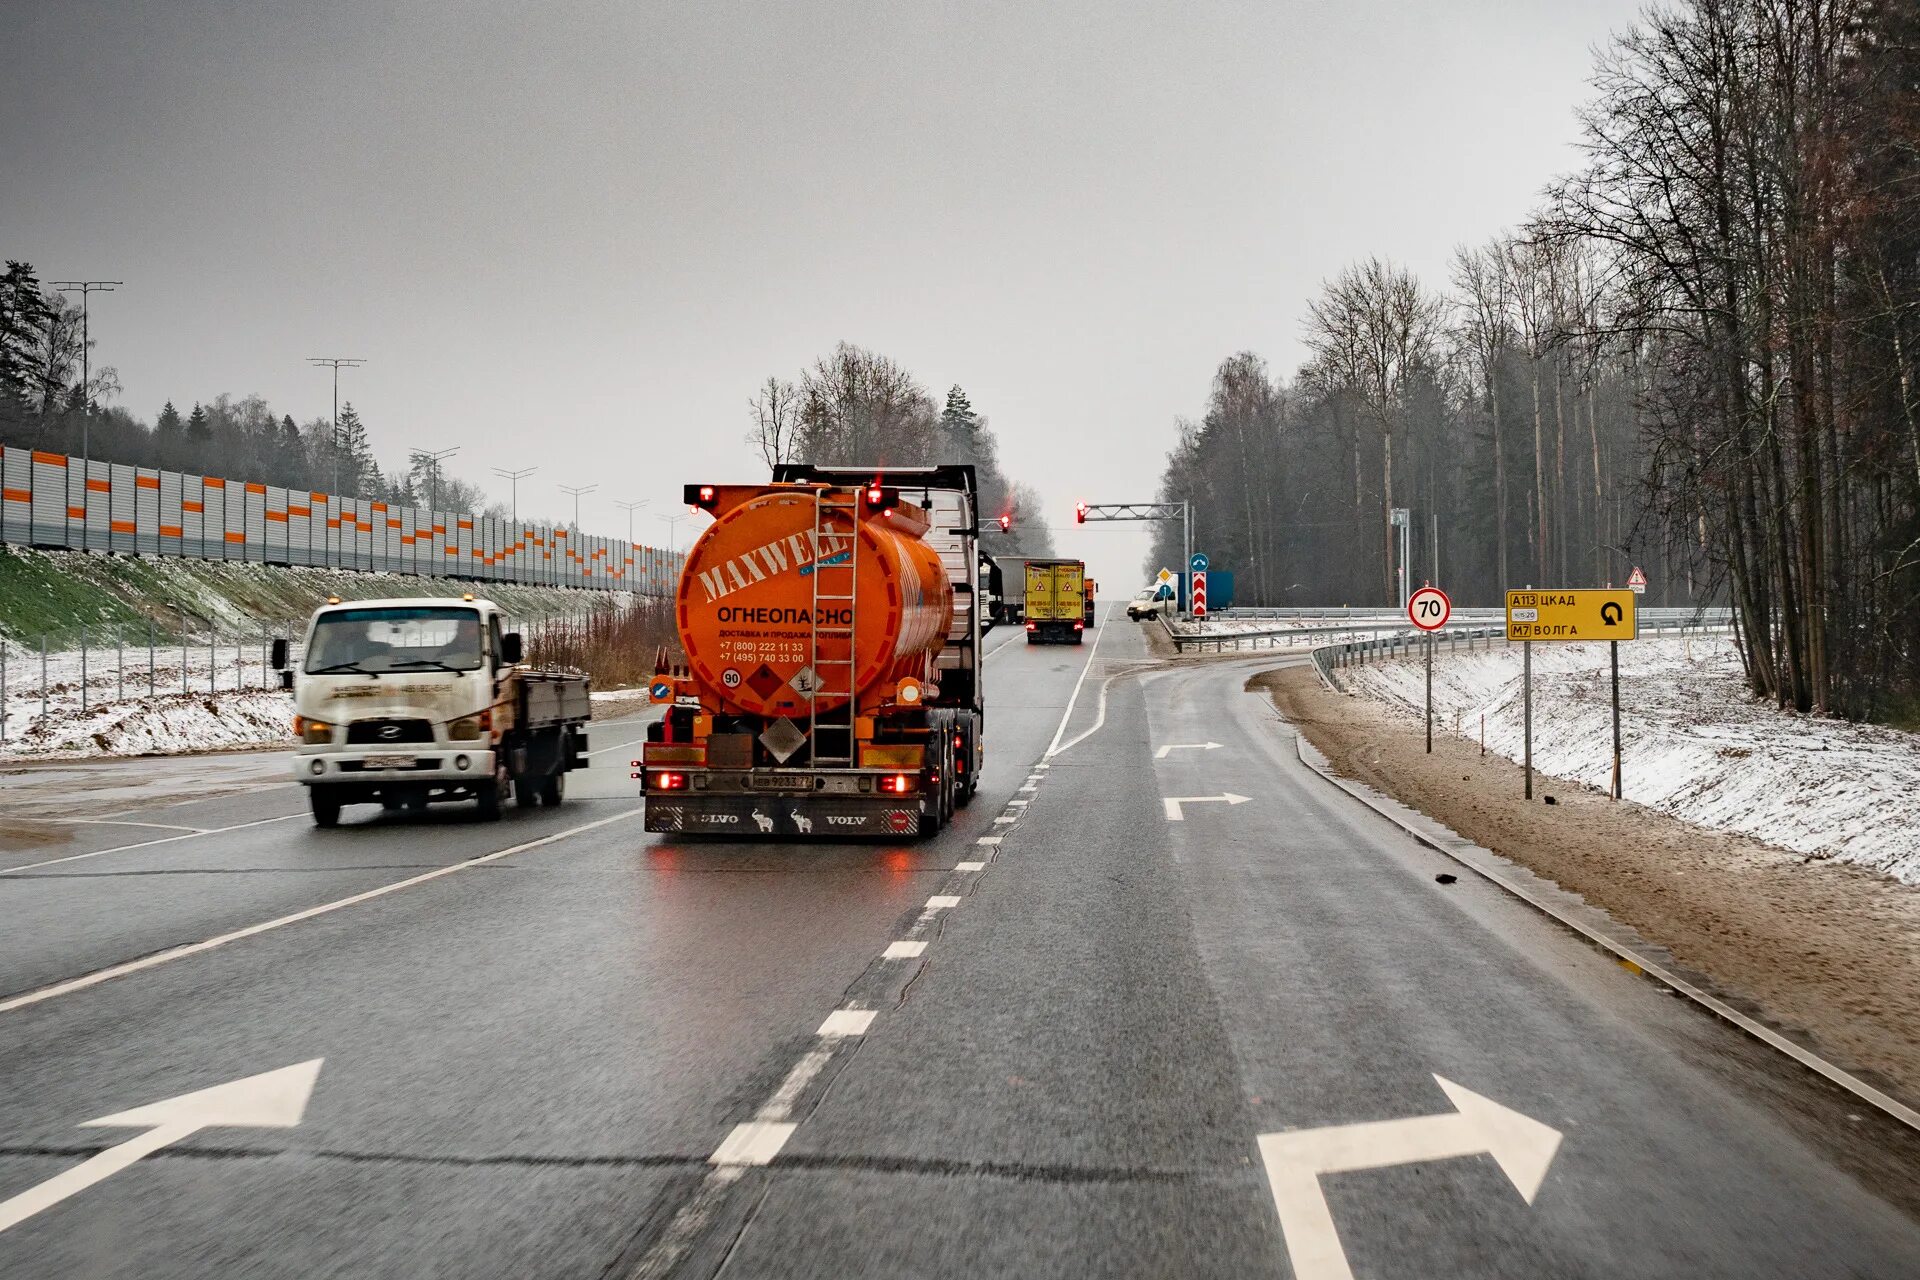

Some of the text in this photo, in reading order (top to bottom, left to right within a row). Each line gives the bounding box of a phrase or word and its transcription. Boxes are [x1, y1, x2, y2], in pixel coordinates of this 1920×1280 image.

[696, 521, 849, 604] MAXWELL
[1512, 595, 1576, 607] А113 ЦКАД
[1418, 600, 1441, 618] 70
[717, 606, 853, 625] ОГНЕОПАСНО
[719, 629, 761, 639] ДОСТАВКА
[770, 630, 811, 640] ПРОДАЖА
[1512, 625, 1578, 636] М7 ВОЛГА
[719, 641, 804, 653] +7 (800) 222 11 33
[719, 652, 804, 664] +7 (495) 740 33 00
[724, 673, 739, 684] 90
